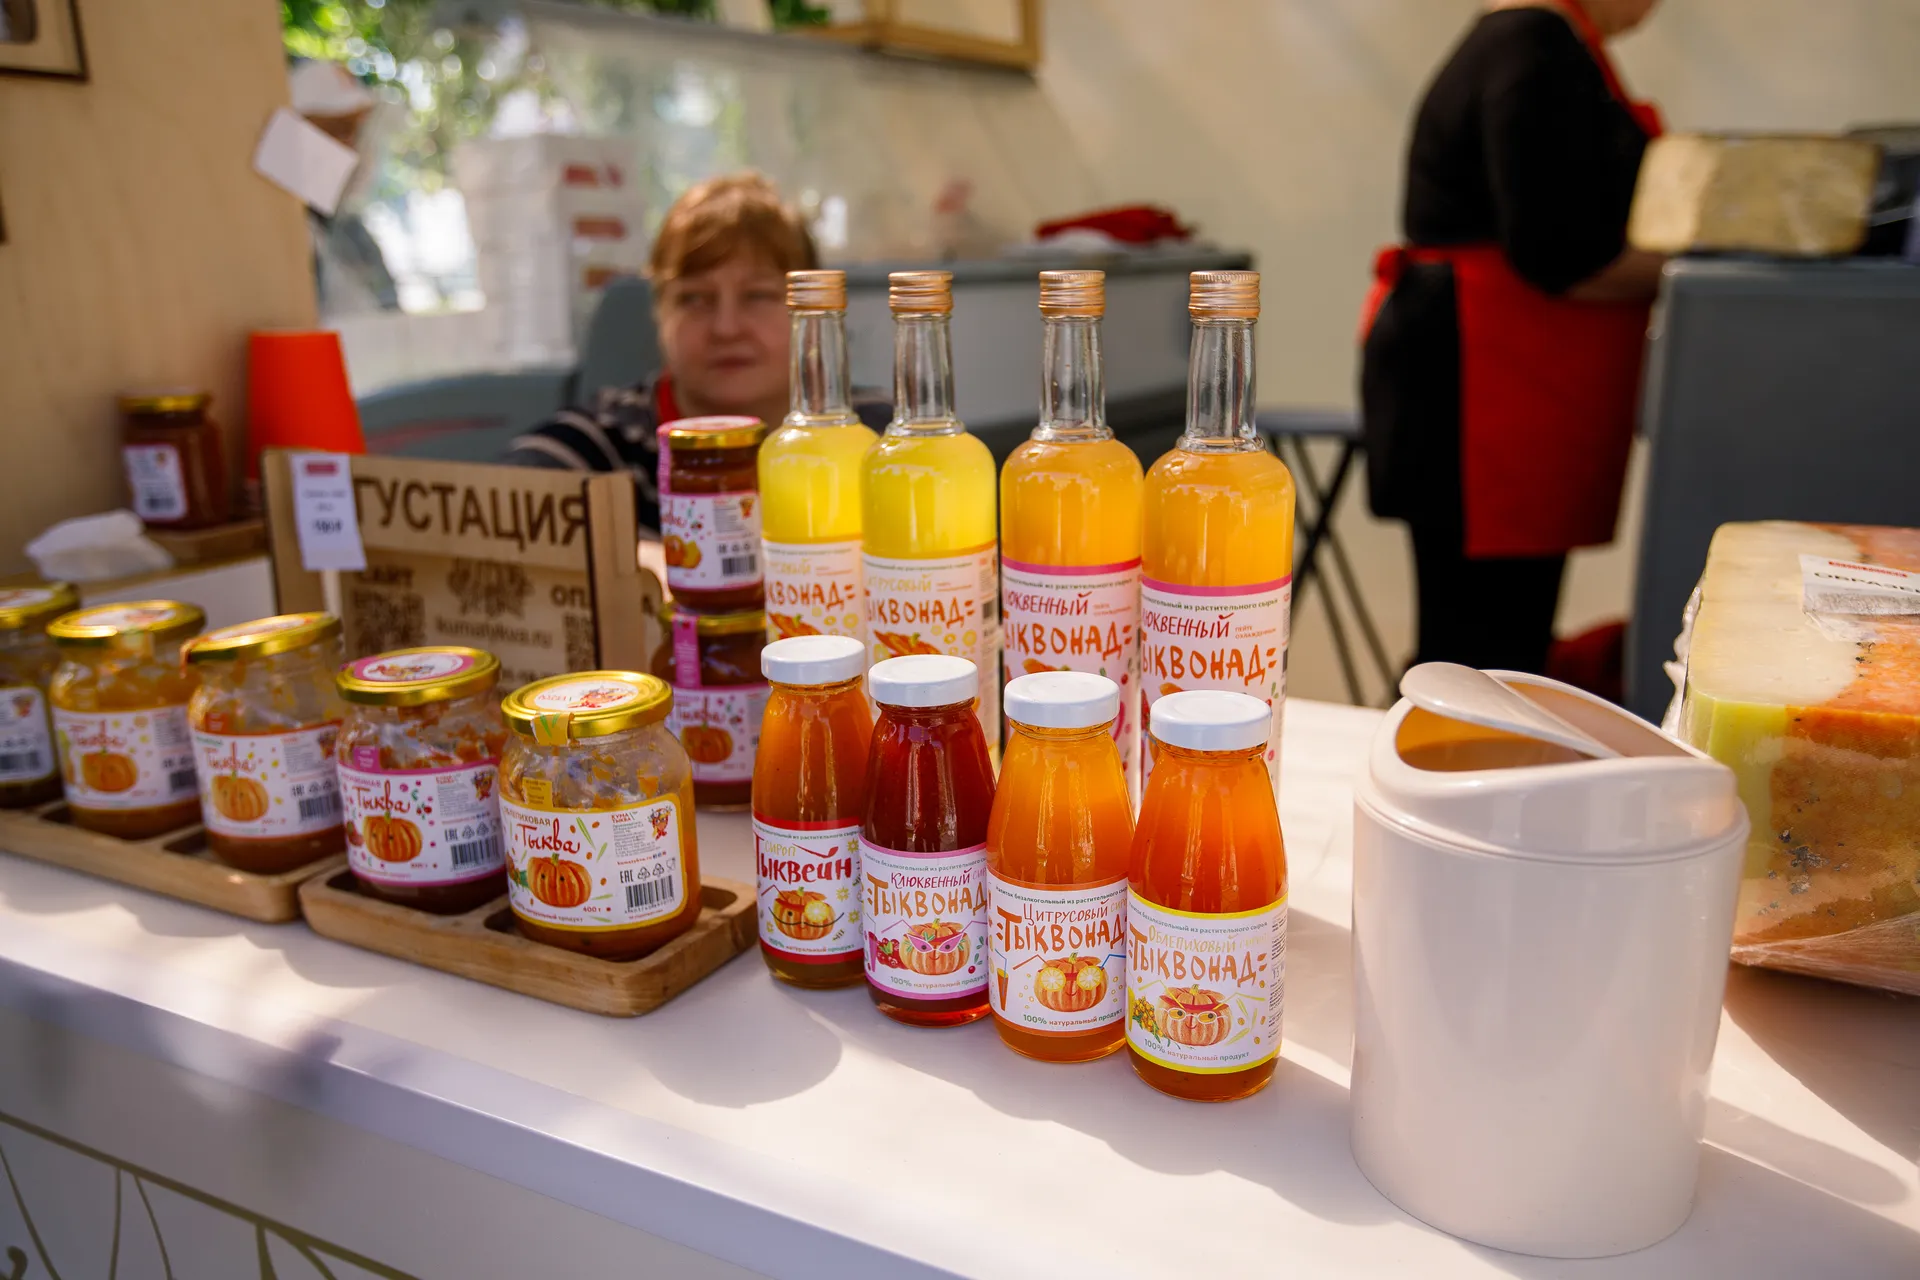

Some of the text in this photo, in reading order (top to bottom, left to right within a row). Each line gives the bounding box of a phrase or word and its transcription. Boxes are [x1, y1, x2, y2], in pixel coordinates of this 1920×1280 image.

[353, 476, 588, 551] ГУСТАЦИЯ
[767, 581, 844, 611] КВОНАД
[1195, 602, 1257, 612] растительного
[867, 597, 964, 629] ЫКВОНАД
[1005, 621, 1122, 662] ЫКВОНАД
[1143, 643, 1265, 687] ЫКВОНАД
[516, 817, 581, 854] Тыква
[764, 840, 797, 857] СИРОП
[891, 867, 972, 889] КЛЮКВЕННЫЙ
[1014, 893, 1066, 904] безалкогольный
[1076, 891, 1119, 904] растительного
[1023, 898, 1109, 926] ЦИТРУСОВЫЙ
[1148, 924, 1239, 953] ОБЛЕПИХОВЫЙ
[1200, 926, 1249, 934] растительного
[1250, 921, 1268, 932] сырья
[890, 976, 912, 987] 100%
[914, 981, 961, 989] натуральный
[1023, 1008, 1123, 1026] 100% натуральный продукт
[1144, 1038, 1250, 1062] 100% натуральный продукт
